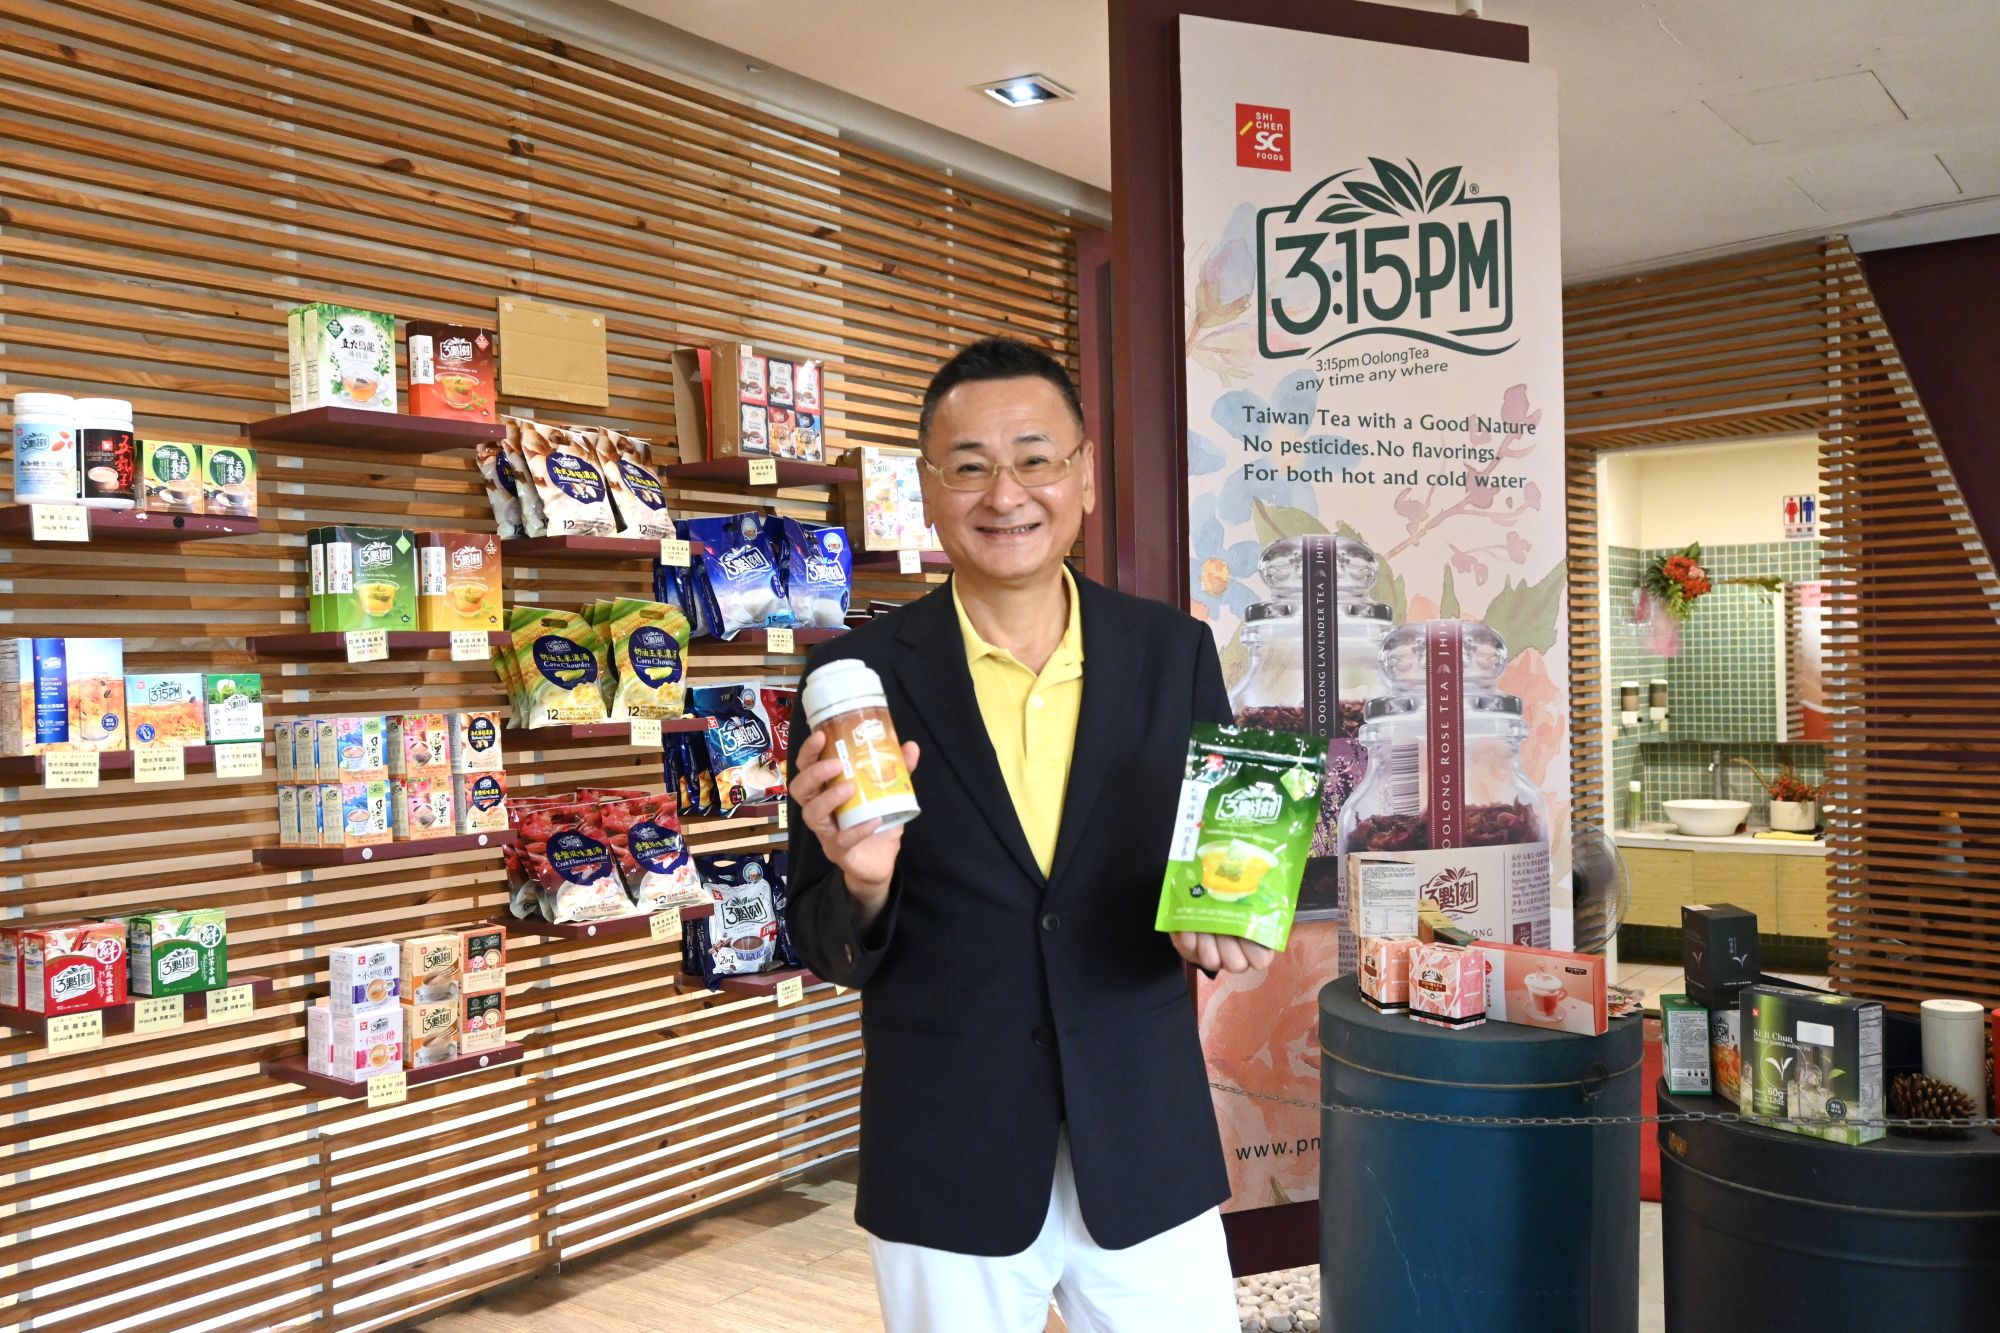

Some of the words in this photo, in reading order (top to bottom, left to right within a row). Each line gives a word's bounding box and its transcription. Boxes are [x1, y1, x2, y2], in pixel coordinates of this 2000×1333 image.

[1255, 111, 1273, 121] SHI
[1254, 131, 1283, 152] SC
[1256, 152, 1284, 161] FOODS
[1271, 219, 1499, 335] 3:15PM
[1316, 357, 1359, 373] 3:15pm
[1295, 377, 1324, 392] any
[1329, 370, 1365, 387] time
[1369, 368, 1397, 383] any
[1400, 361, 1449, 378] where
[1242, 406, 1309, 425] Taiwan
[1317, 409, 1351, 427] Tea
[1358, 413, 1396, 429] with
[1403, 419, 1412, 430] a
[1420, 414, 1470, 432] Good
[1477, 417, 1536, 435] Nature
[1243, 435, 1272, 452] No
[1412, 442, 1501, 463] flavorings.
[1243, 464, 1278, 482] For
[1286, 466, 1333, 483] both
[1342, 468, 1375, 484] hot
[1382, 470, 1418, 485] and
[1426, 471, 1467, 487] cold
[1474, 475, 1527, 489] water
[563, 520, 575, 529] 12
[639, 525, 648, 535] 12
[1316, 582, 1325, 604] TEA
[1317, 608, 1326, 668] LAVENDER
[1317, 670, 1327, 724] OOLONG
[1440, 681, 1449, 713] TEA
[546, 709, 559, 720] 12
[628, 706, 640, 717] 12
[1441, 721, 1450, 765] ROSE
[655, 896, 667, 904] 12
[726, 903, 763, 925] 3點1刻
[201, 925, 221, 946] 鮮
[98, 940, 119, 962] 鮮
[162, 955, 194, 976] 3點1刻
[56, 972, 91, 993] 3點1刻
[1768, 1087, 1784, 1099] 60g
